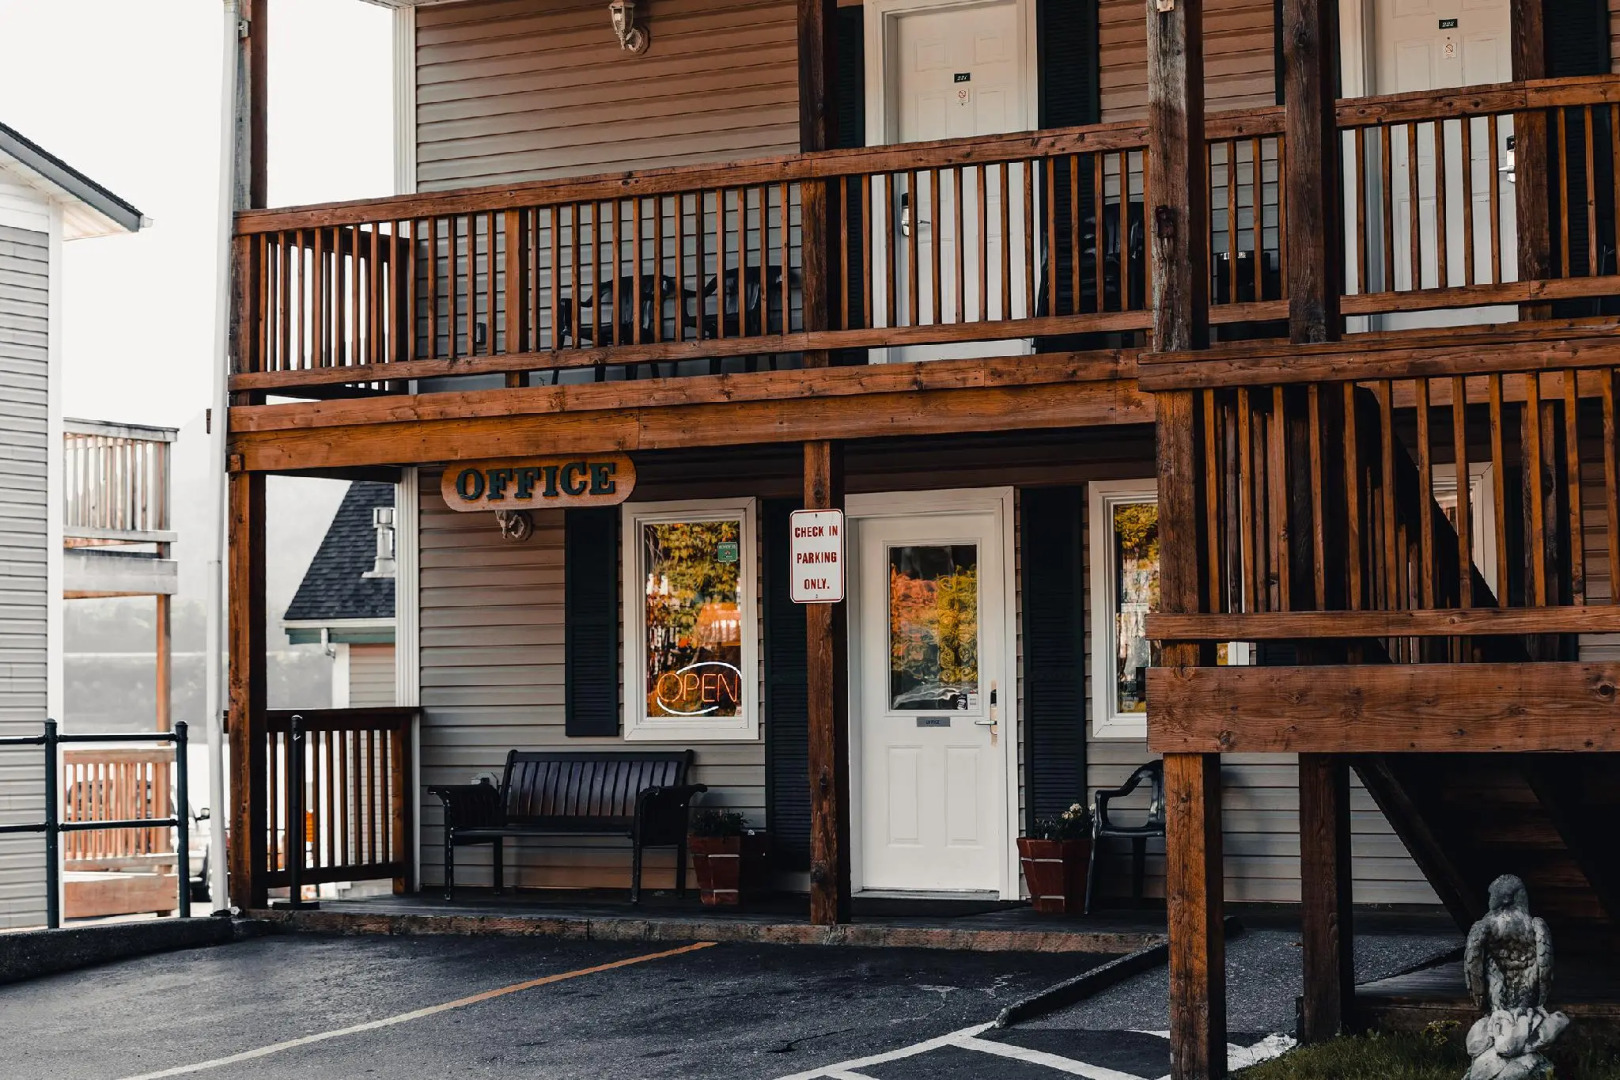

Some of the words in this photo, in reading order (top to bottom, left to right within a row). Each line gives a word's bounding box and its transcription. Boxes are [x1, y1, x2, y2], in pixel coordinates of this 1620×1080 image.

[456, 461, 617, 501] OFFICE
[794, 526, 824, 538] CHECK
[829, 525, 838, 536] IN
[796, 551, 837, 564] PARKING
[804, 578, 830, 590] ONLY.
[657, 672, 738, 702] OPEN
